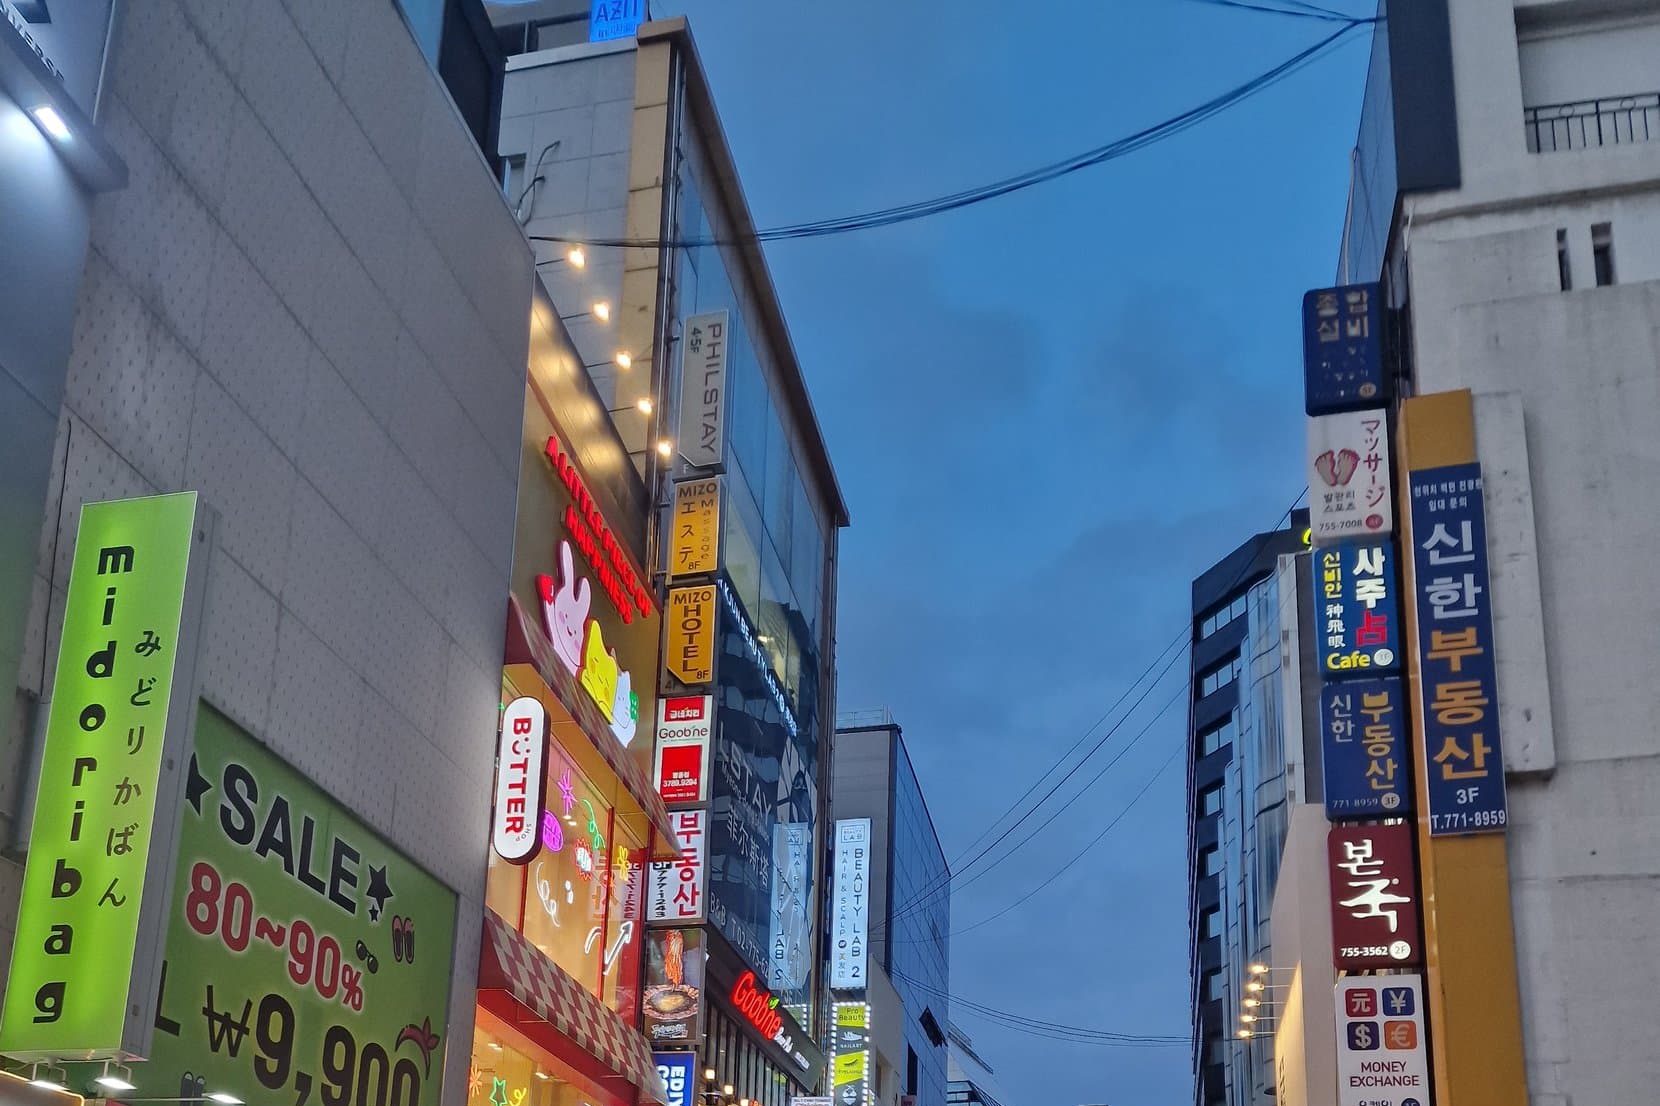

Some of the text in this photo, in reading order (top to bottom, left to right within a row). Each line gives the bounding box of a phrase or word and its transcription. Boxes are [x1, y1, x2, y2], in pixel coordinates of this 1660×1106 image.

[701, 323, 722, 453] PHILSTAY
[679, 482, 717, 498] MIZO
[679, 502, 696, 564] エステ
[674, 591, 712, 605] MIZO
[681, 605, 702, 672] HOTEL
[1327, 650, 1371, 669] Cafe
[659, 726, 708, 739] Goobne
[1331, 695, 1355, 743] 신한
[1360, 691, 1399, 790] 부동산
[97, 630, 161, 908] みどりかばん
[1457, 788, 1479, 803] 3F
[220, 763, 360, 915] SALE
[673, 813, 702, 917] 부동산
[851, 848, 864, 978] BEAUTY LAB 2
[1337, 839, 1411, 933] 본죽
[187, 862, 363, 1012] 80~90%
[1340, 946, 1388, 957] 755-3562
[731, 970, 783, 1041] Goobne
[838, 1013, 865, 1022] Beauty
[1351, 993, 1371, 1013] 元
[1350, 1076, 1420, 1088] EXCHANGE
[1361, 1061, 1407, 1074] MONEY
